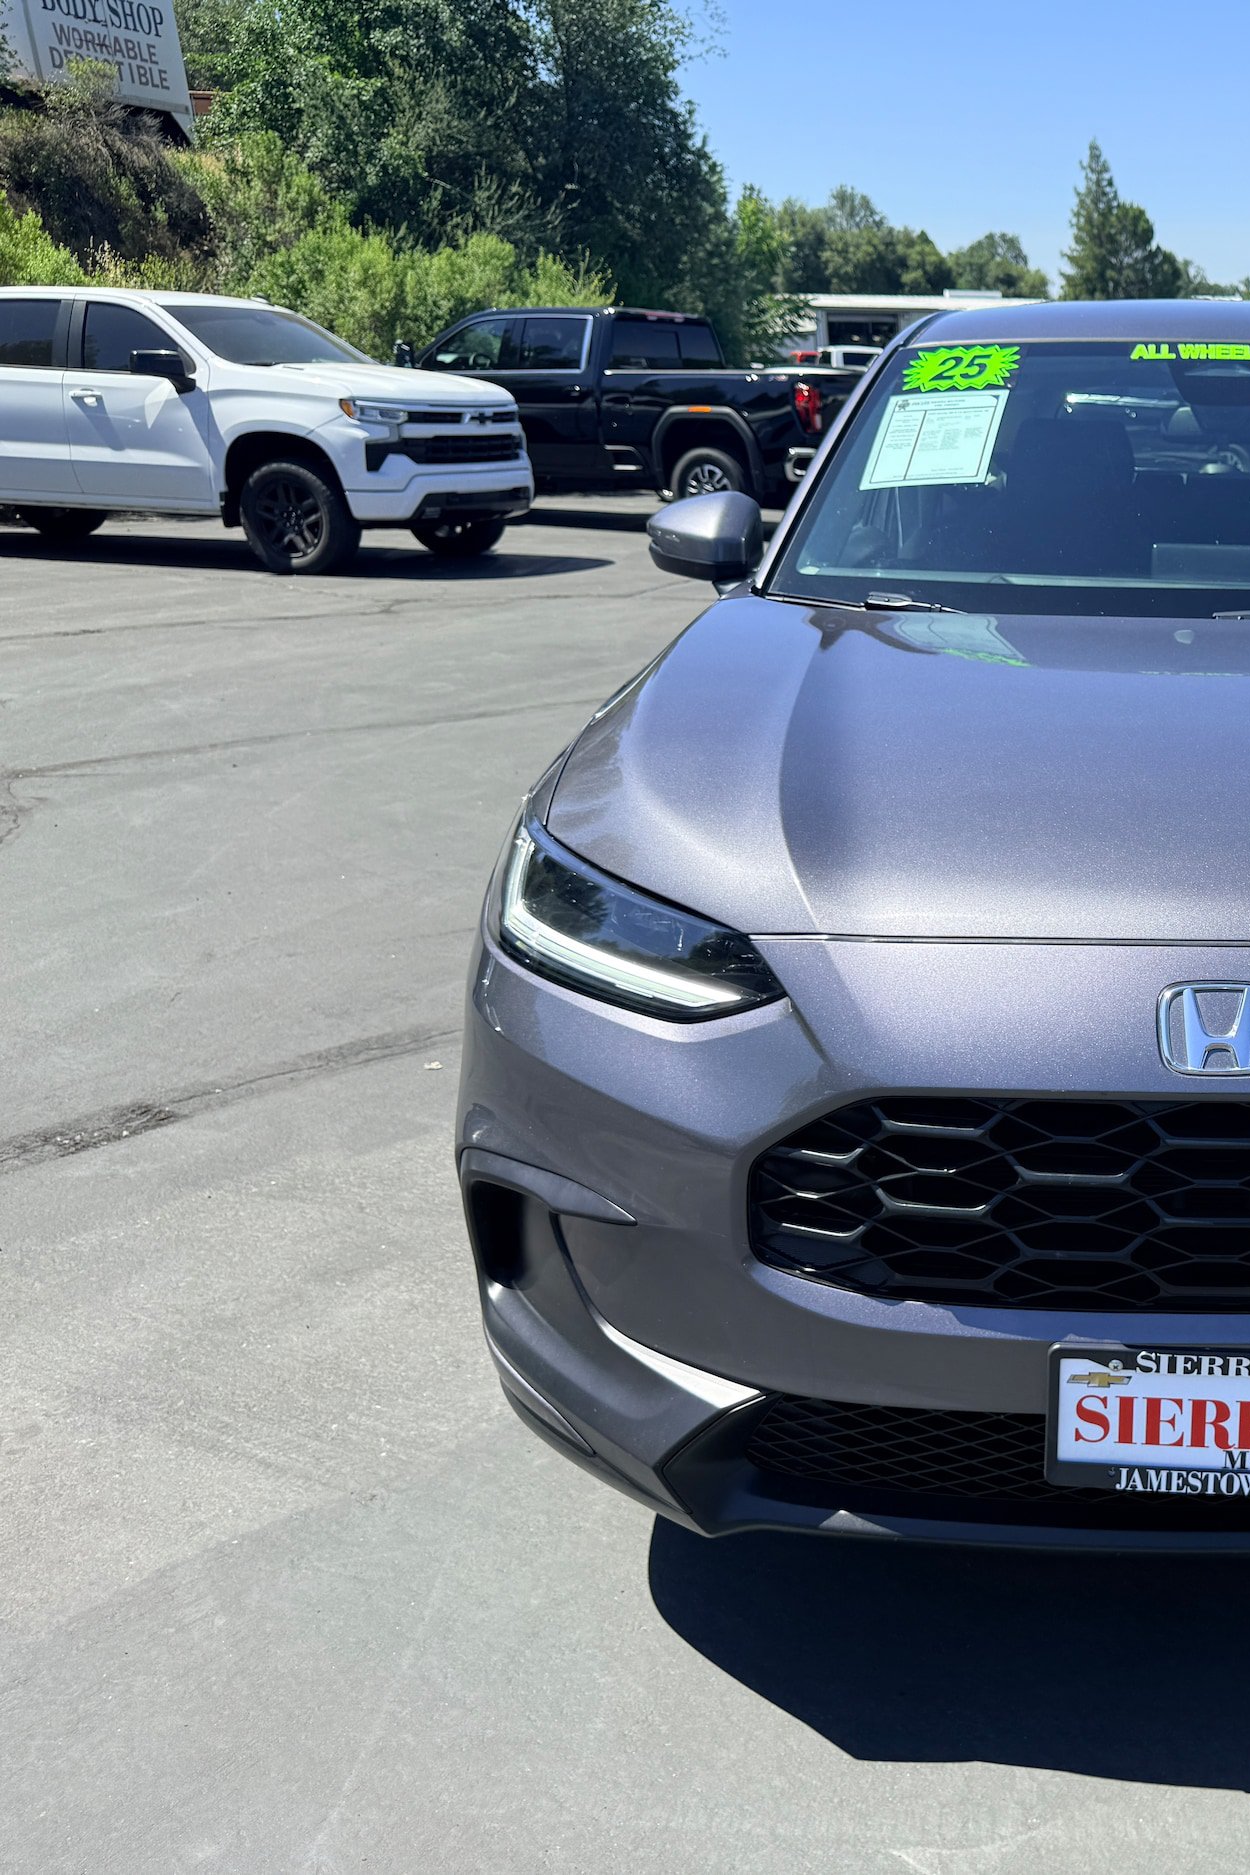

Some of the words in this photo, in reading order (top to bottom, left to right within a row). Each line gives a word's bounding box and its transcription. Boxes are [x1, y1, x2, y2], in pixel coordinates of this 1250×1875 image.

[106, 0, 164, 38] SHOP
[51, 22, 159, 65] WORKABLE
[929, 354, 991, 381] 25
[1130, 344, 1176, 360] ALL
